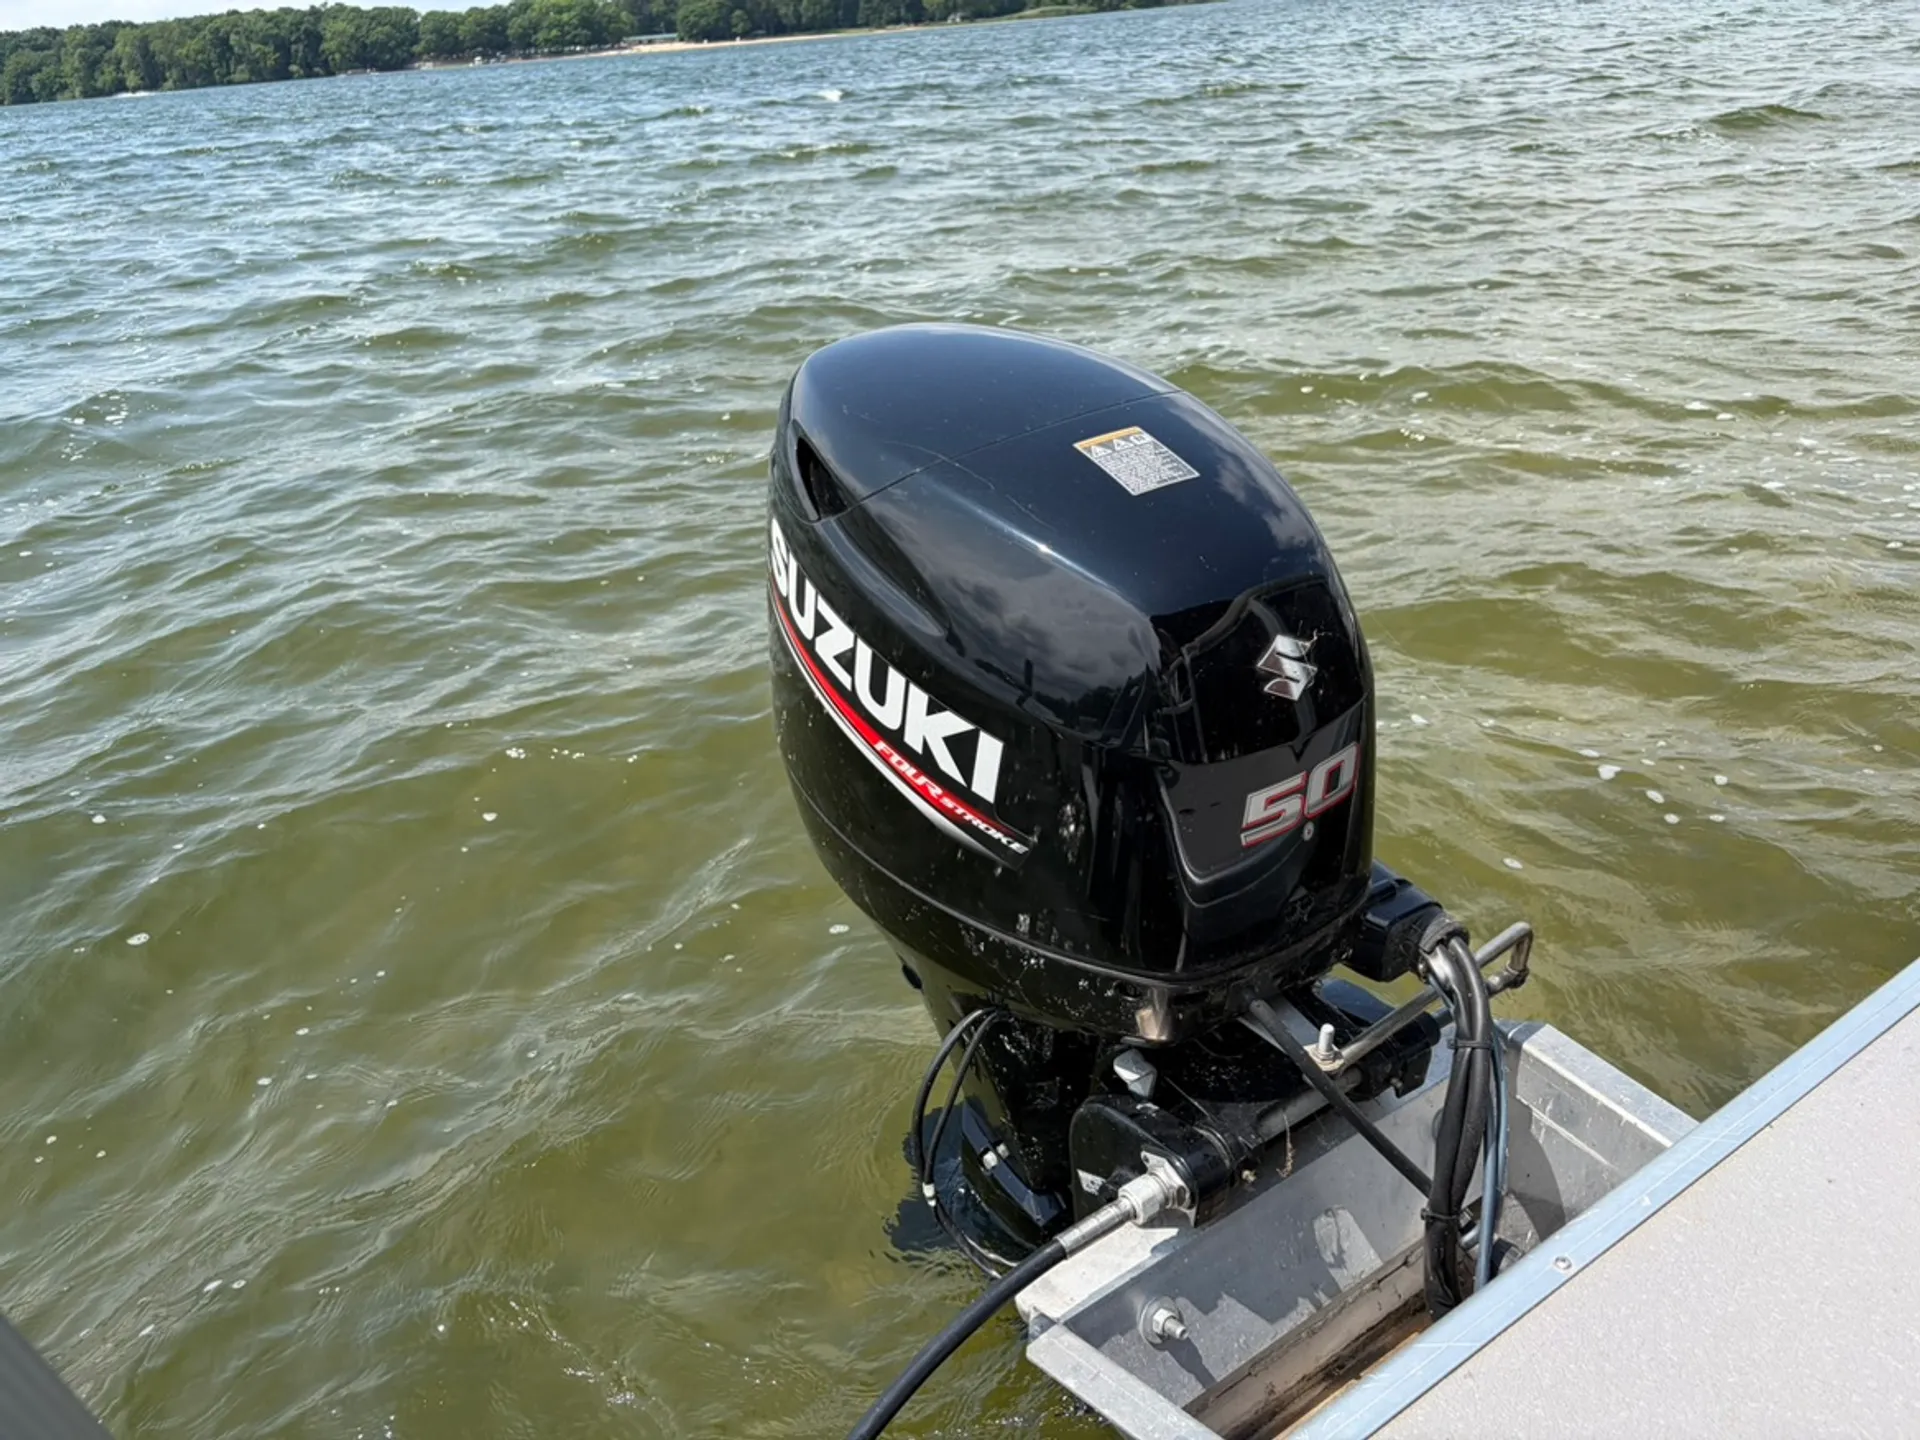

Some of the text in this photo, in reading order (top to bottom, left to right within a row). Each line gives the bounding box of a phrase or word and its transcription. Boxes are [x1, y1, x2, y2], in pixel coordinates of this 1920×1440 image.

[771, 517, 1004, 804] SUZUKI
[874, 740, 943, 799] FOUR
[1240, 741, 1361, 847] 50
